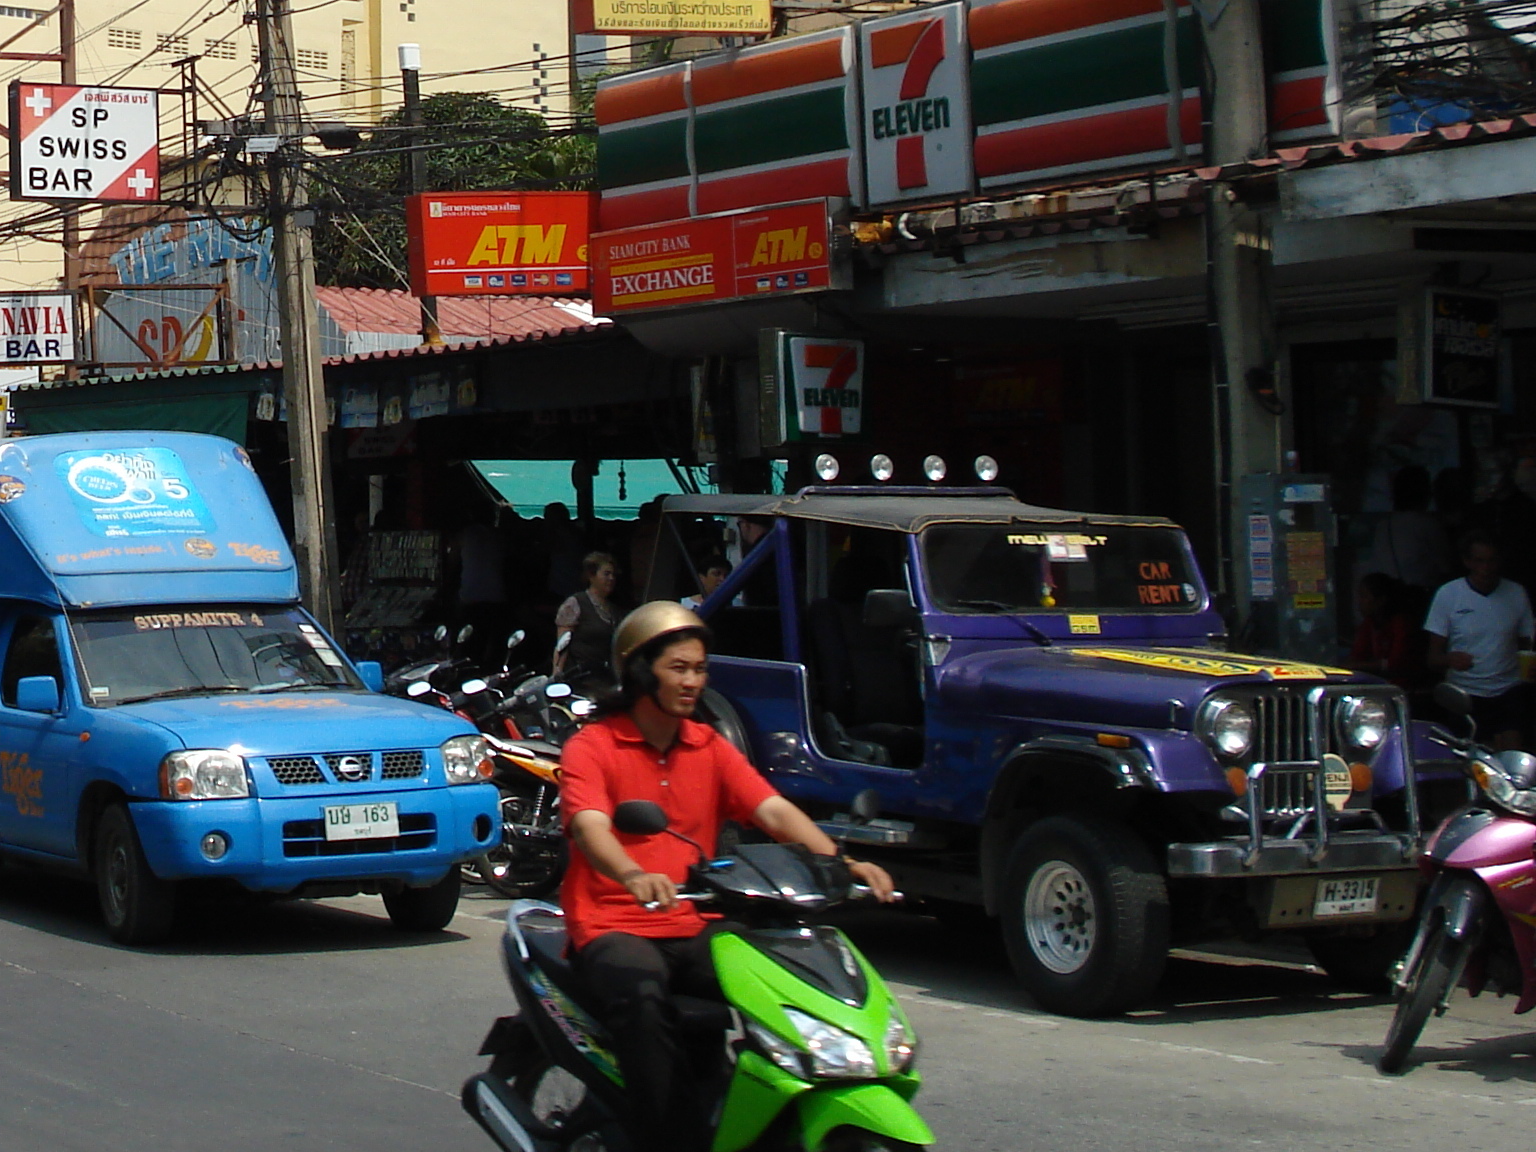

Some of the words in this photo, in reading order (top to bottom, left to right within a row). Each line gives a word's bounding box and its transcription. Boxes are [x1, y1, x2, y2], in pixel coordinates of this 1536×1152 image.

[71, 107, 109, 129] SP
[39, 136, 127, 161] SWISS
[28, 167, 93, 192] BAR
[467, 224, 567, 265] ATM
[610, 243, 634, 260] SIAM
[635, 238, 659, 256] CITY
[663, 234, 690, 251] BANK
[751, 226, 808, 267] ATM
[611, 265, 713, 295] EXCHANGE
[6, 339, 61, 358] BAR
[162, 478, 190, 499] 5
[1139, 562, 1172, 580] CAR
[1137, 584, 1181, 605] RENT
[134, 613, 244, 631] SUPPAMITR
[251, 613, 264, 627] 4
[363, 805, 389, 823] 163
